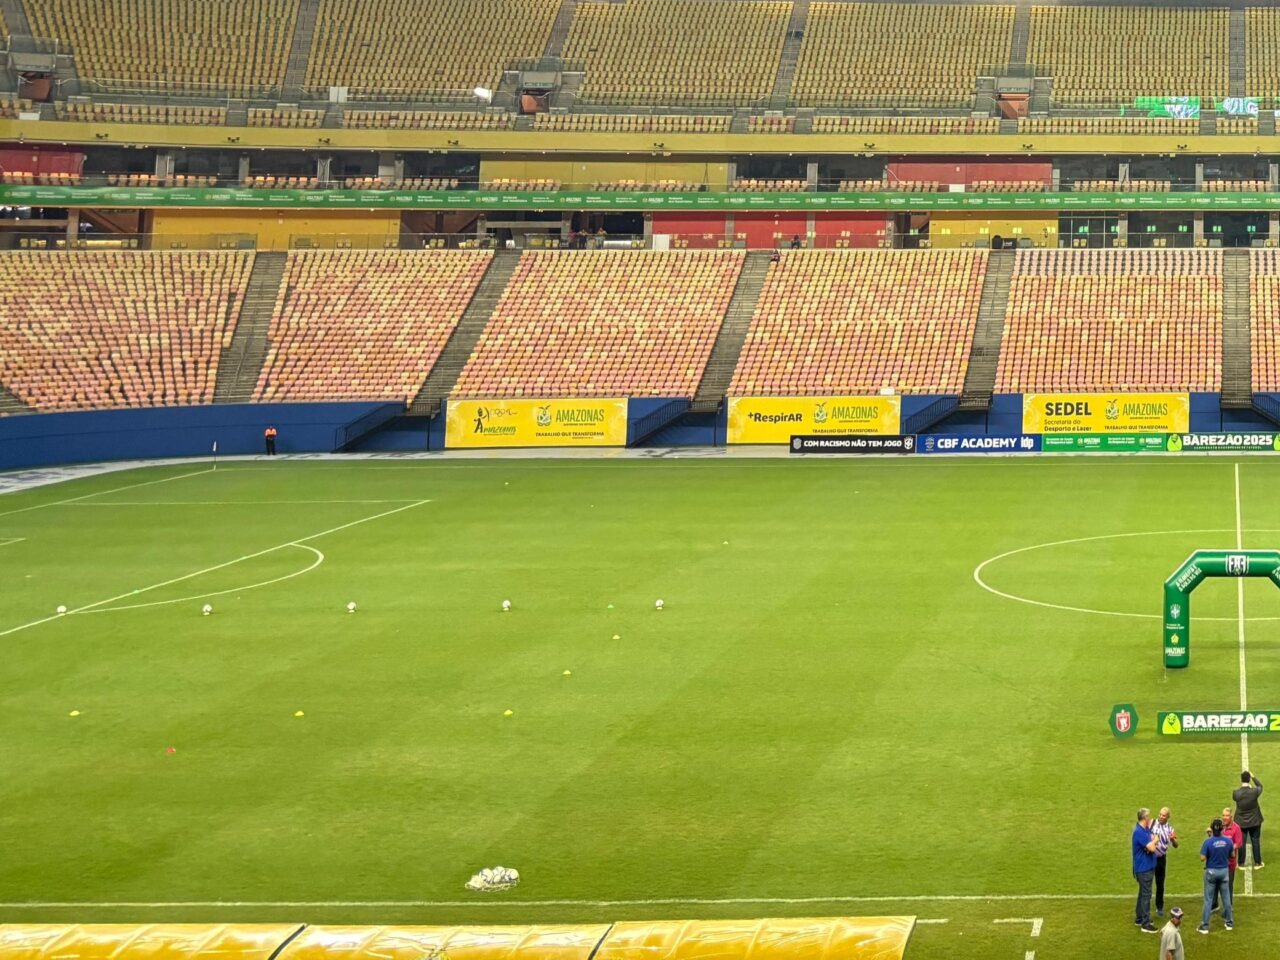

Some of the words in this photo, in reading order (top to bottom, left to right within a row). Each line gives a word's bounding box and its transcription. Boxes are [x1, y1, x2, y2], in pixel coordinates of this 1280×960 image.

[556, 408, 605, 423] AMAZONAS
[831, 406, 879, 419] AMAZONAS
[1045, 402, 1092, 416] SEDEL
[1122, 403, 1168, 416] AMAZONAS
[803, 440, 819, 448] COM
[820, 440, 851, 448] RACISMO
[851, 439, 867, 448] NÃO
[868, 440, 883, 448] TEM
[883, 440, 902, 448] JOGO
[937, 438, 959, 449] CBF
[960, 437, 1017, 449] ACADEMY
[1183, 434, 1242, 445] BAREZÃO
[1243, 435, 1273, 445] 2025
[1182, 712, 1268, 727] BAREZÃO
